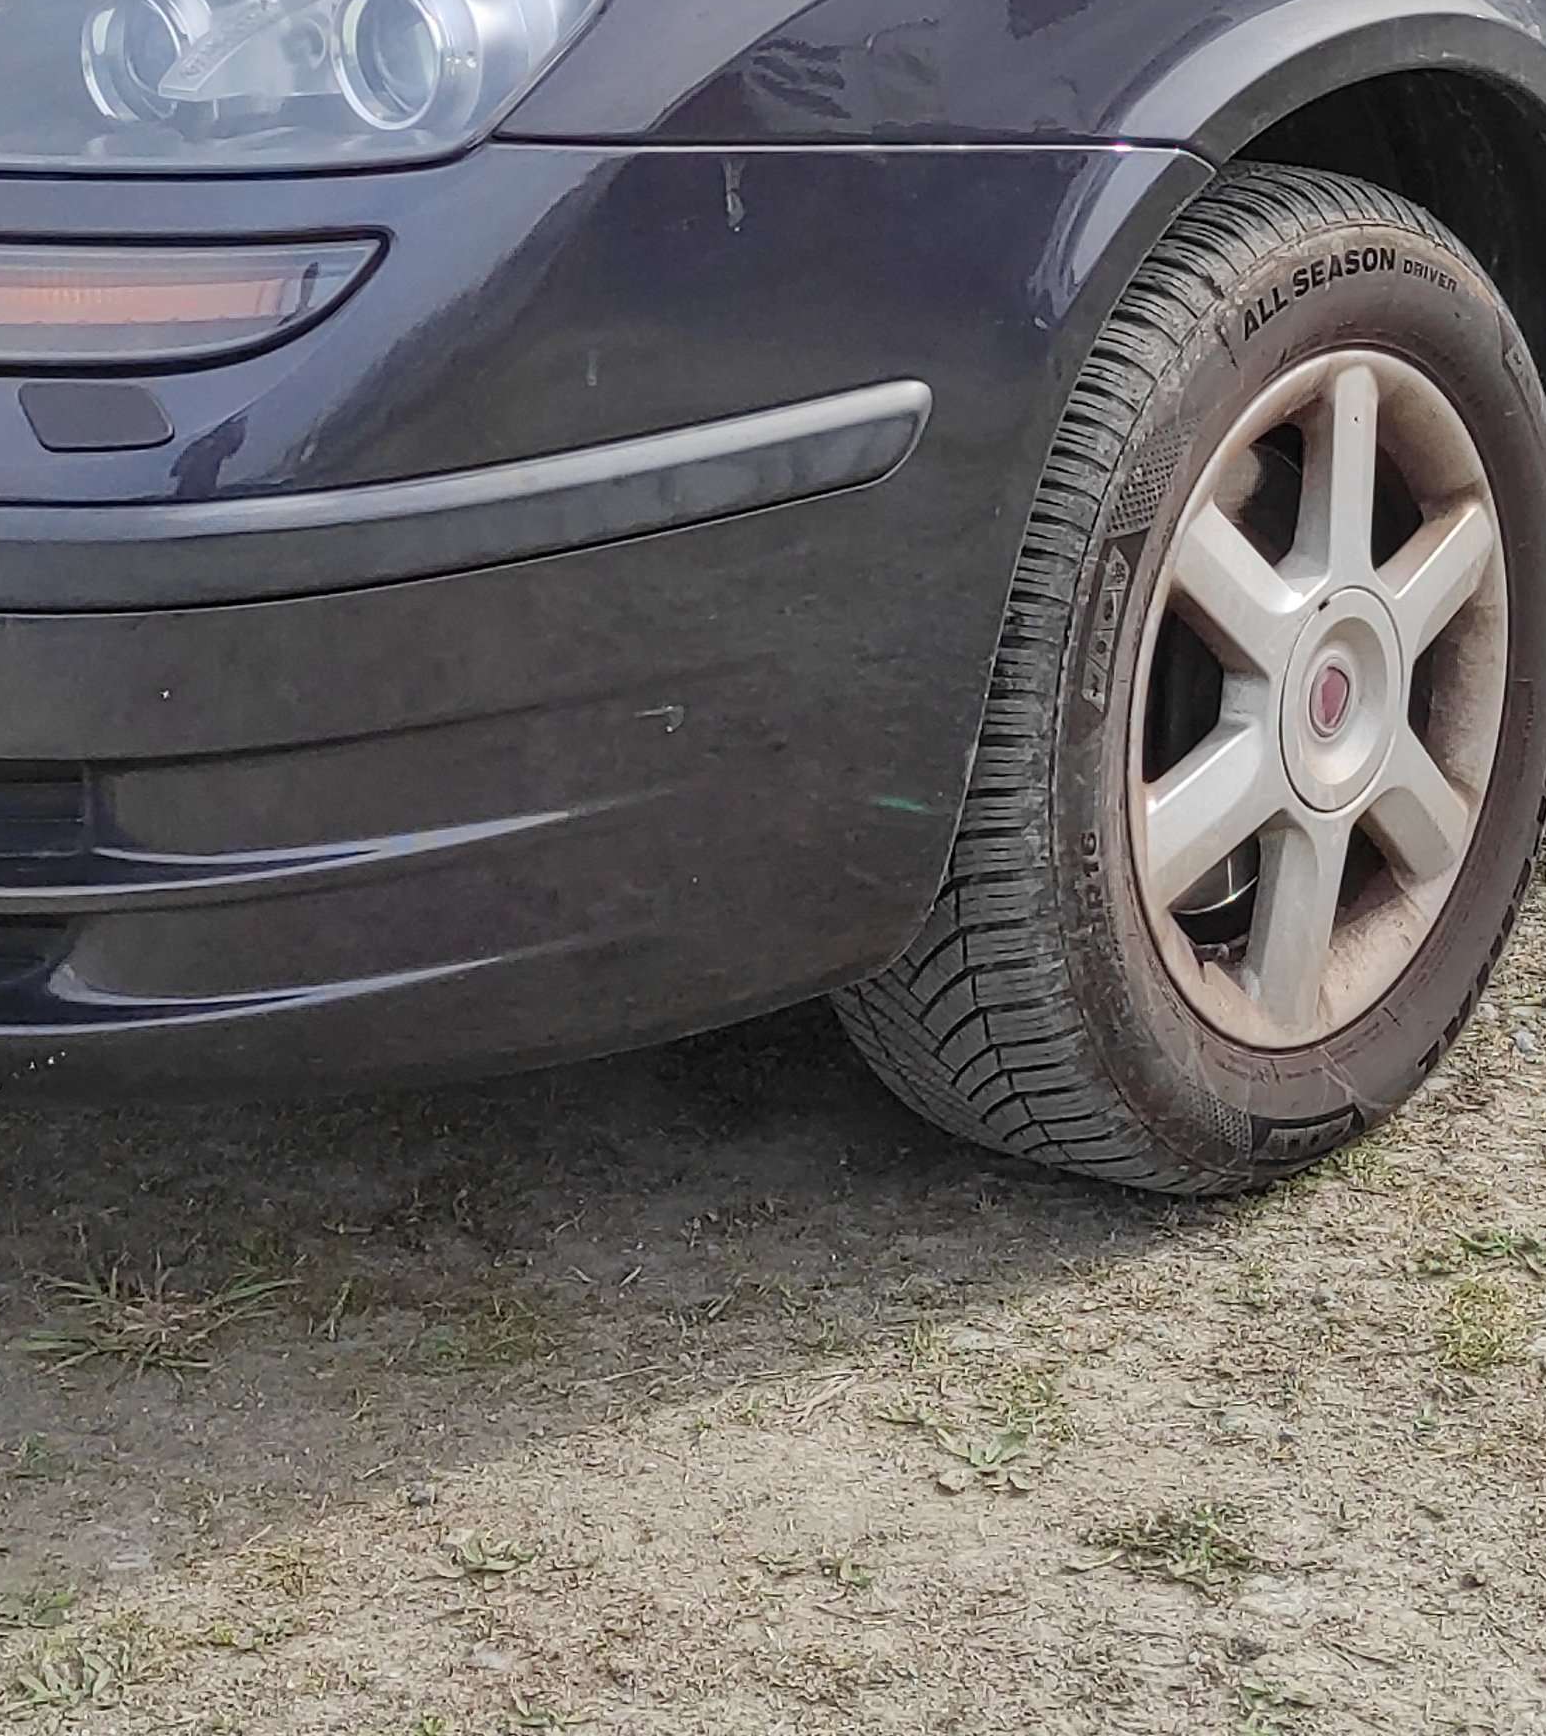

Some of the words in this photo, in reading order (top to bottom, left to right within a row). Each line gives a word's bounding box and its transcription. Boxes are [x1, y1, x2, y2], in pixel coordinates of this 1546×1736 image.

[1242, 286, 1289, 342] ALL
[1292, 247, 1397, 298] SEASON
[1402, 259, 1458, 294] DRIVER
